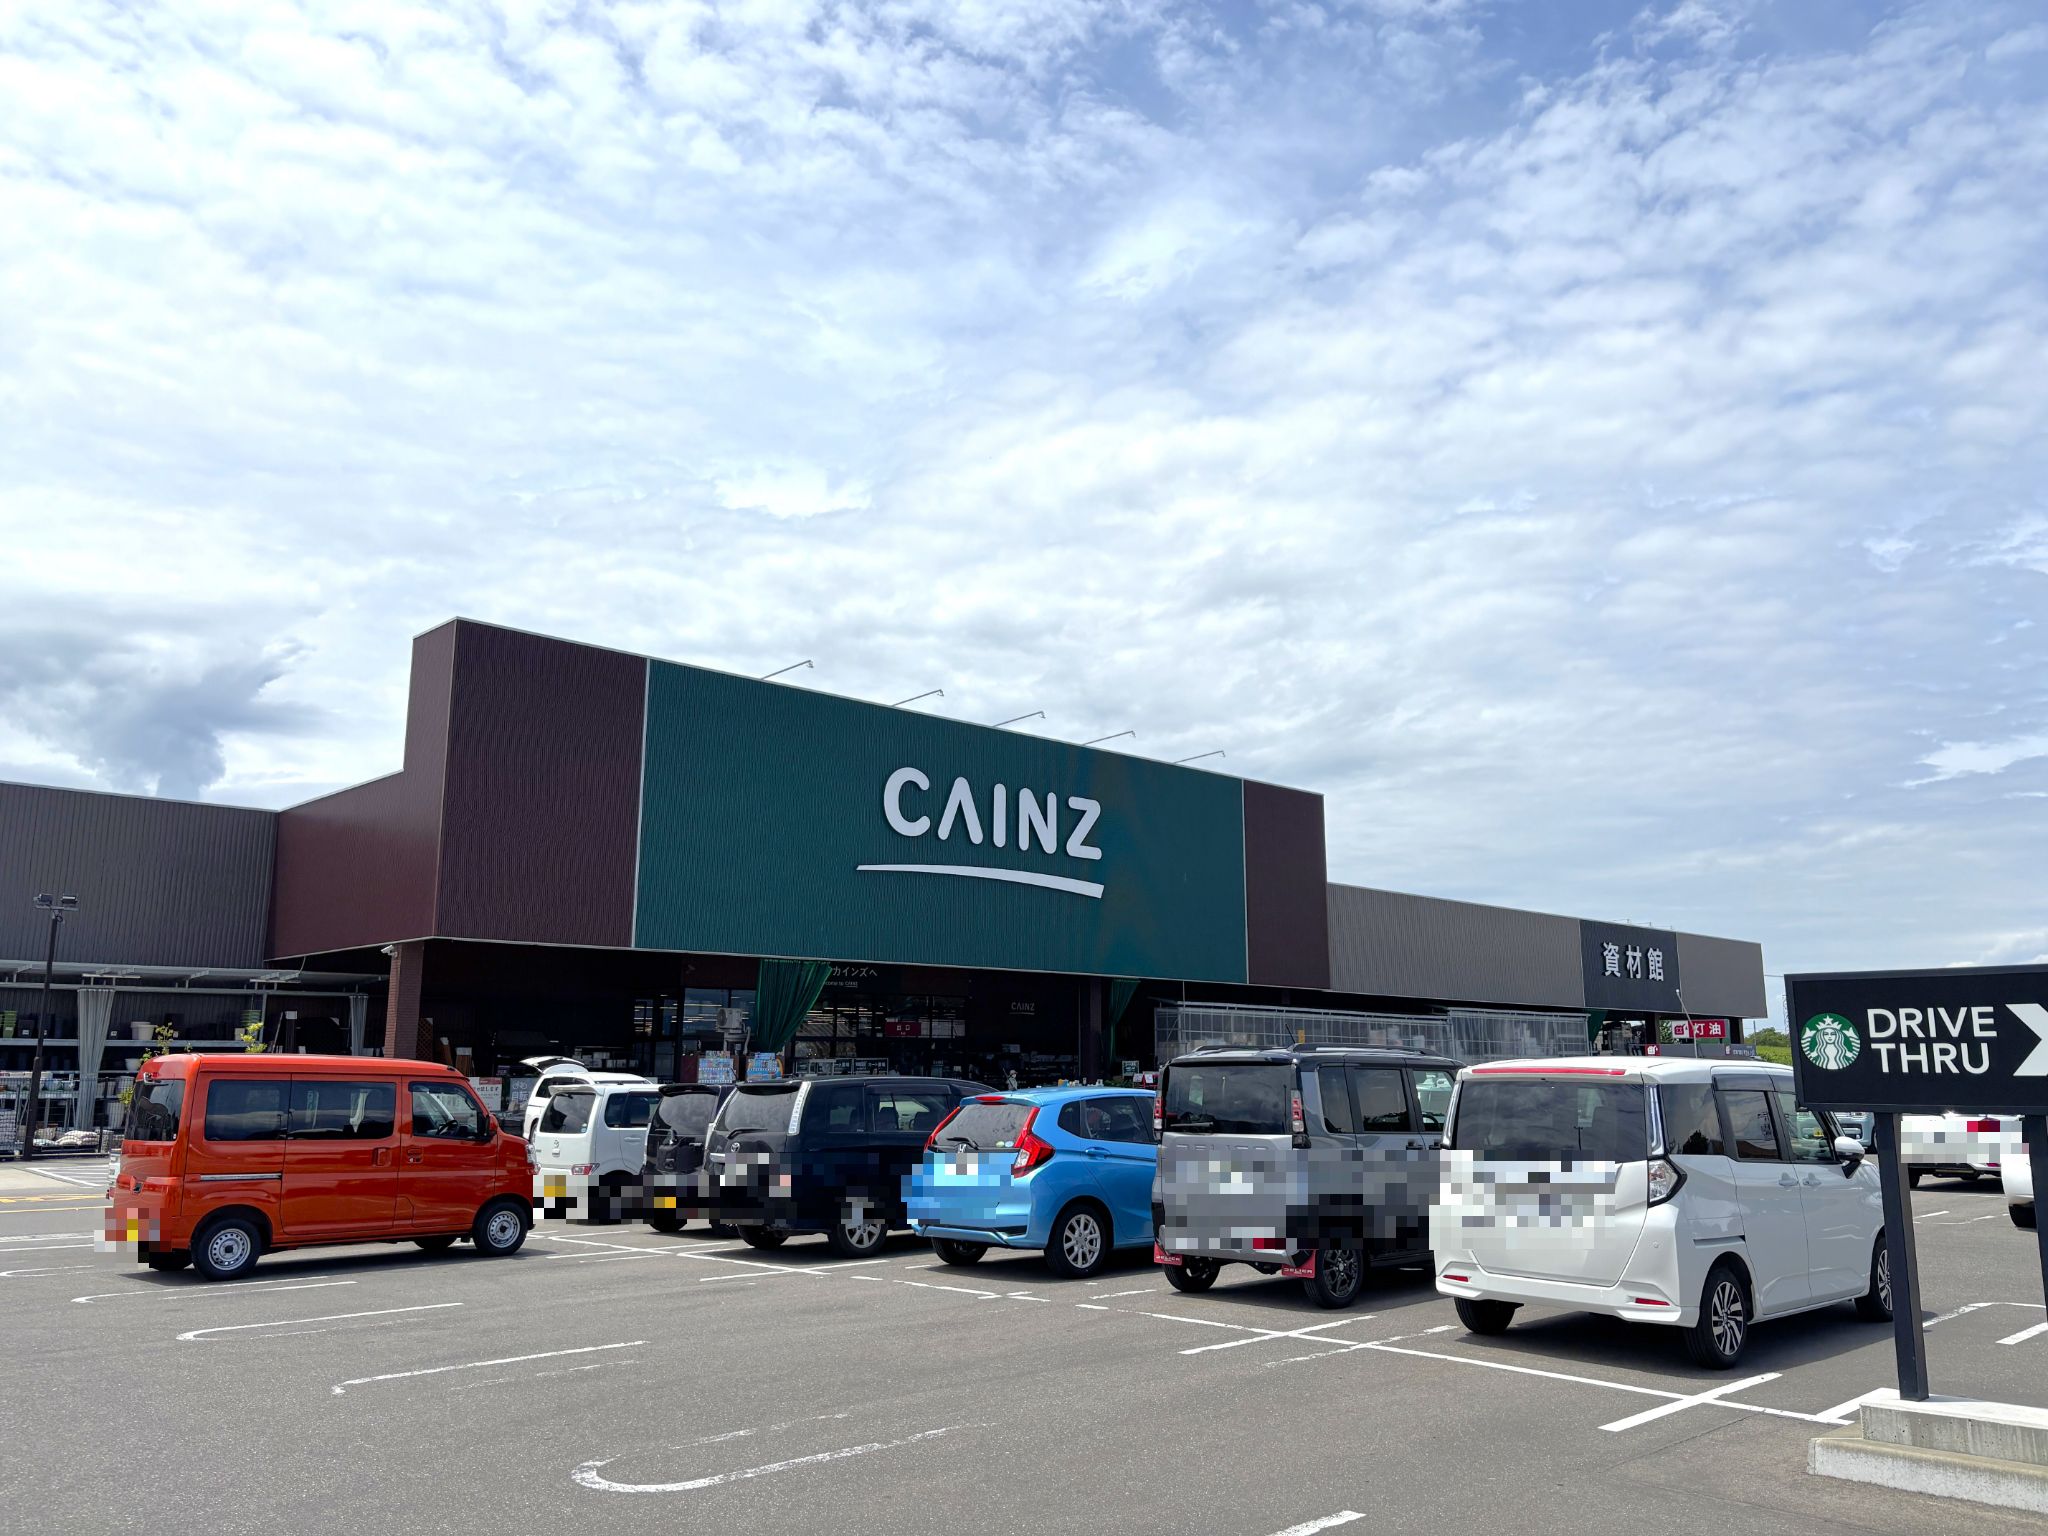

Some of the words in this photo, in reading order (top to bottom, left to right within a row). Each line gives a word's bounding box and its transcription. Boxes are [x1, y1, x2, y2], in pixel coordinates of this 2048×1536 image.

[883, 766, 1103, 861] CAINZ
[1602, 942, 1665, 982] 資材館
[1011, 1001, 1036, 1012] CAINZ
[1867, 1006, 1998, 1039] DRIVE
[1693, 1022, 1722, 1036] 灯油
[1870, 1042, 1990, 1075] THRU
